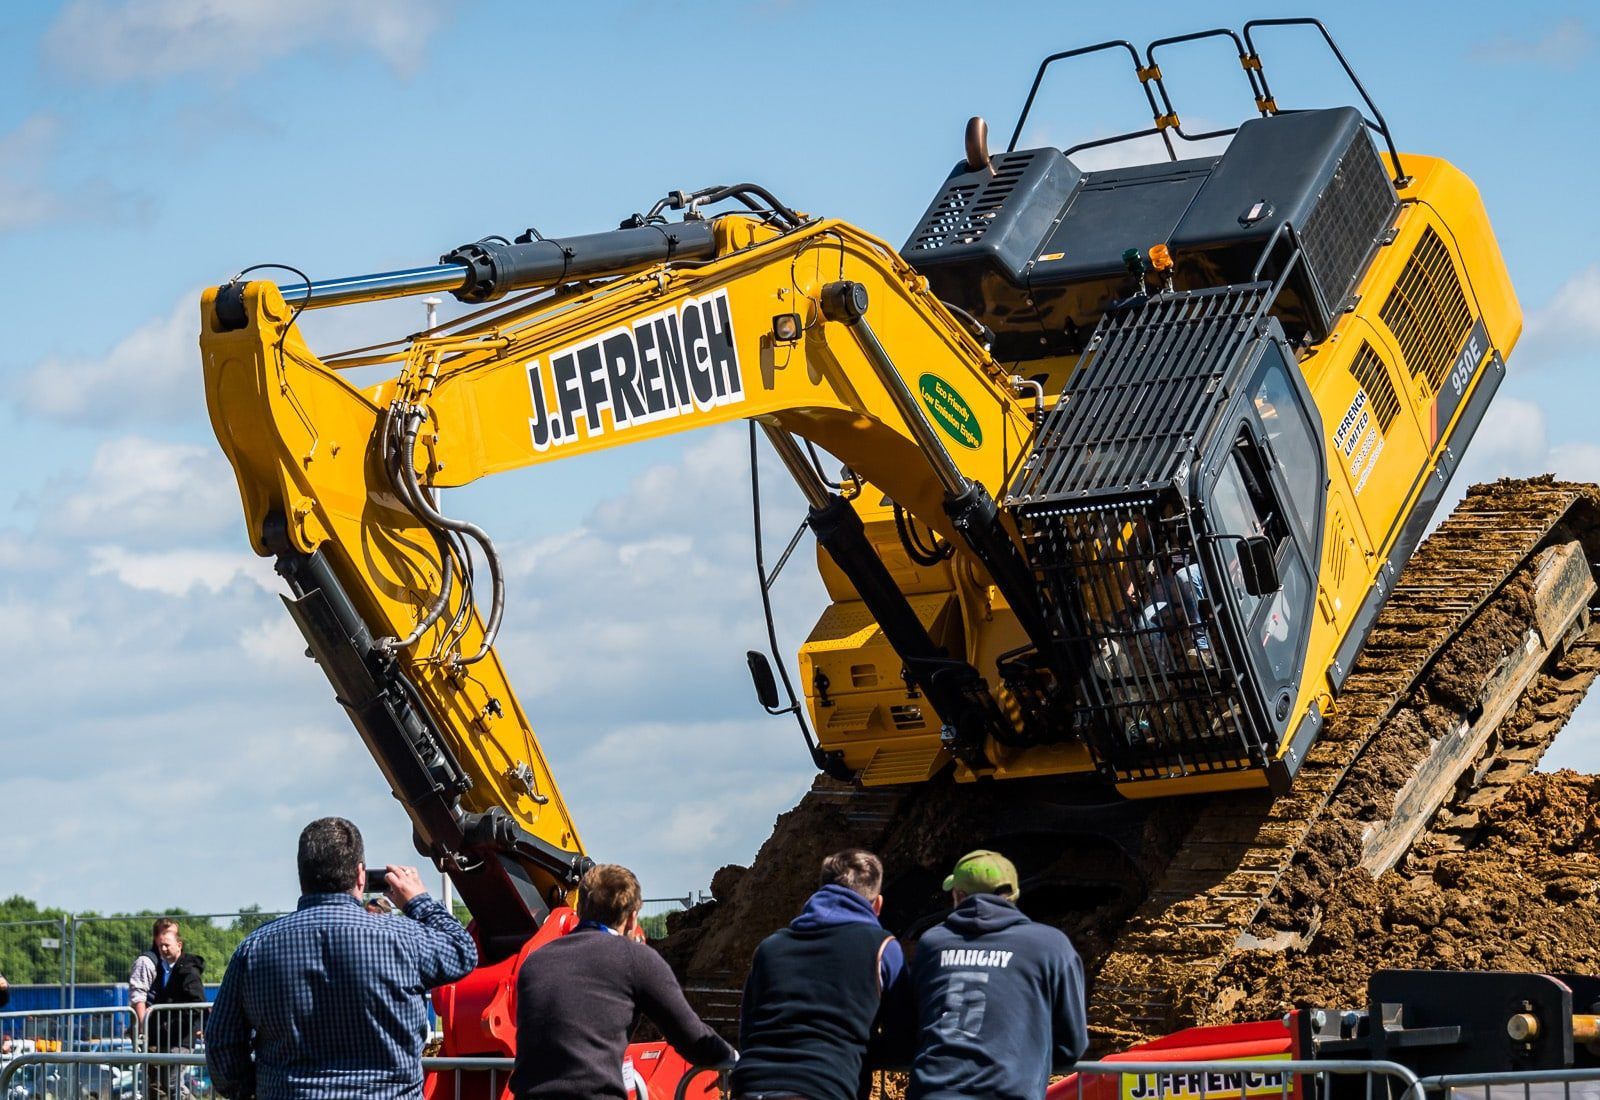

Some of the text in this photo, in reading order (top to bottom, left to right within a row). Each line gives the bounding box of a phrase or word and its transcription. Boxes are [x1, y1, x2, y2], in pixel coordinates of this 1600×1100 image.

[527, 291, 743, 448] J.FFRENCH
[1451, 336, 1482, 396] 950E
[921, 386, 979, 448] Low Emission Engine
[935, 381, 970, 422] Eco Friendly
[1333, 390, 1366, 449] J.FFRENCH
[1344, 411, 1369, 457] LIMITED
